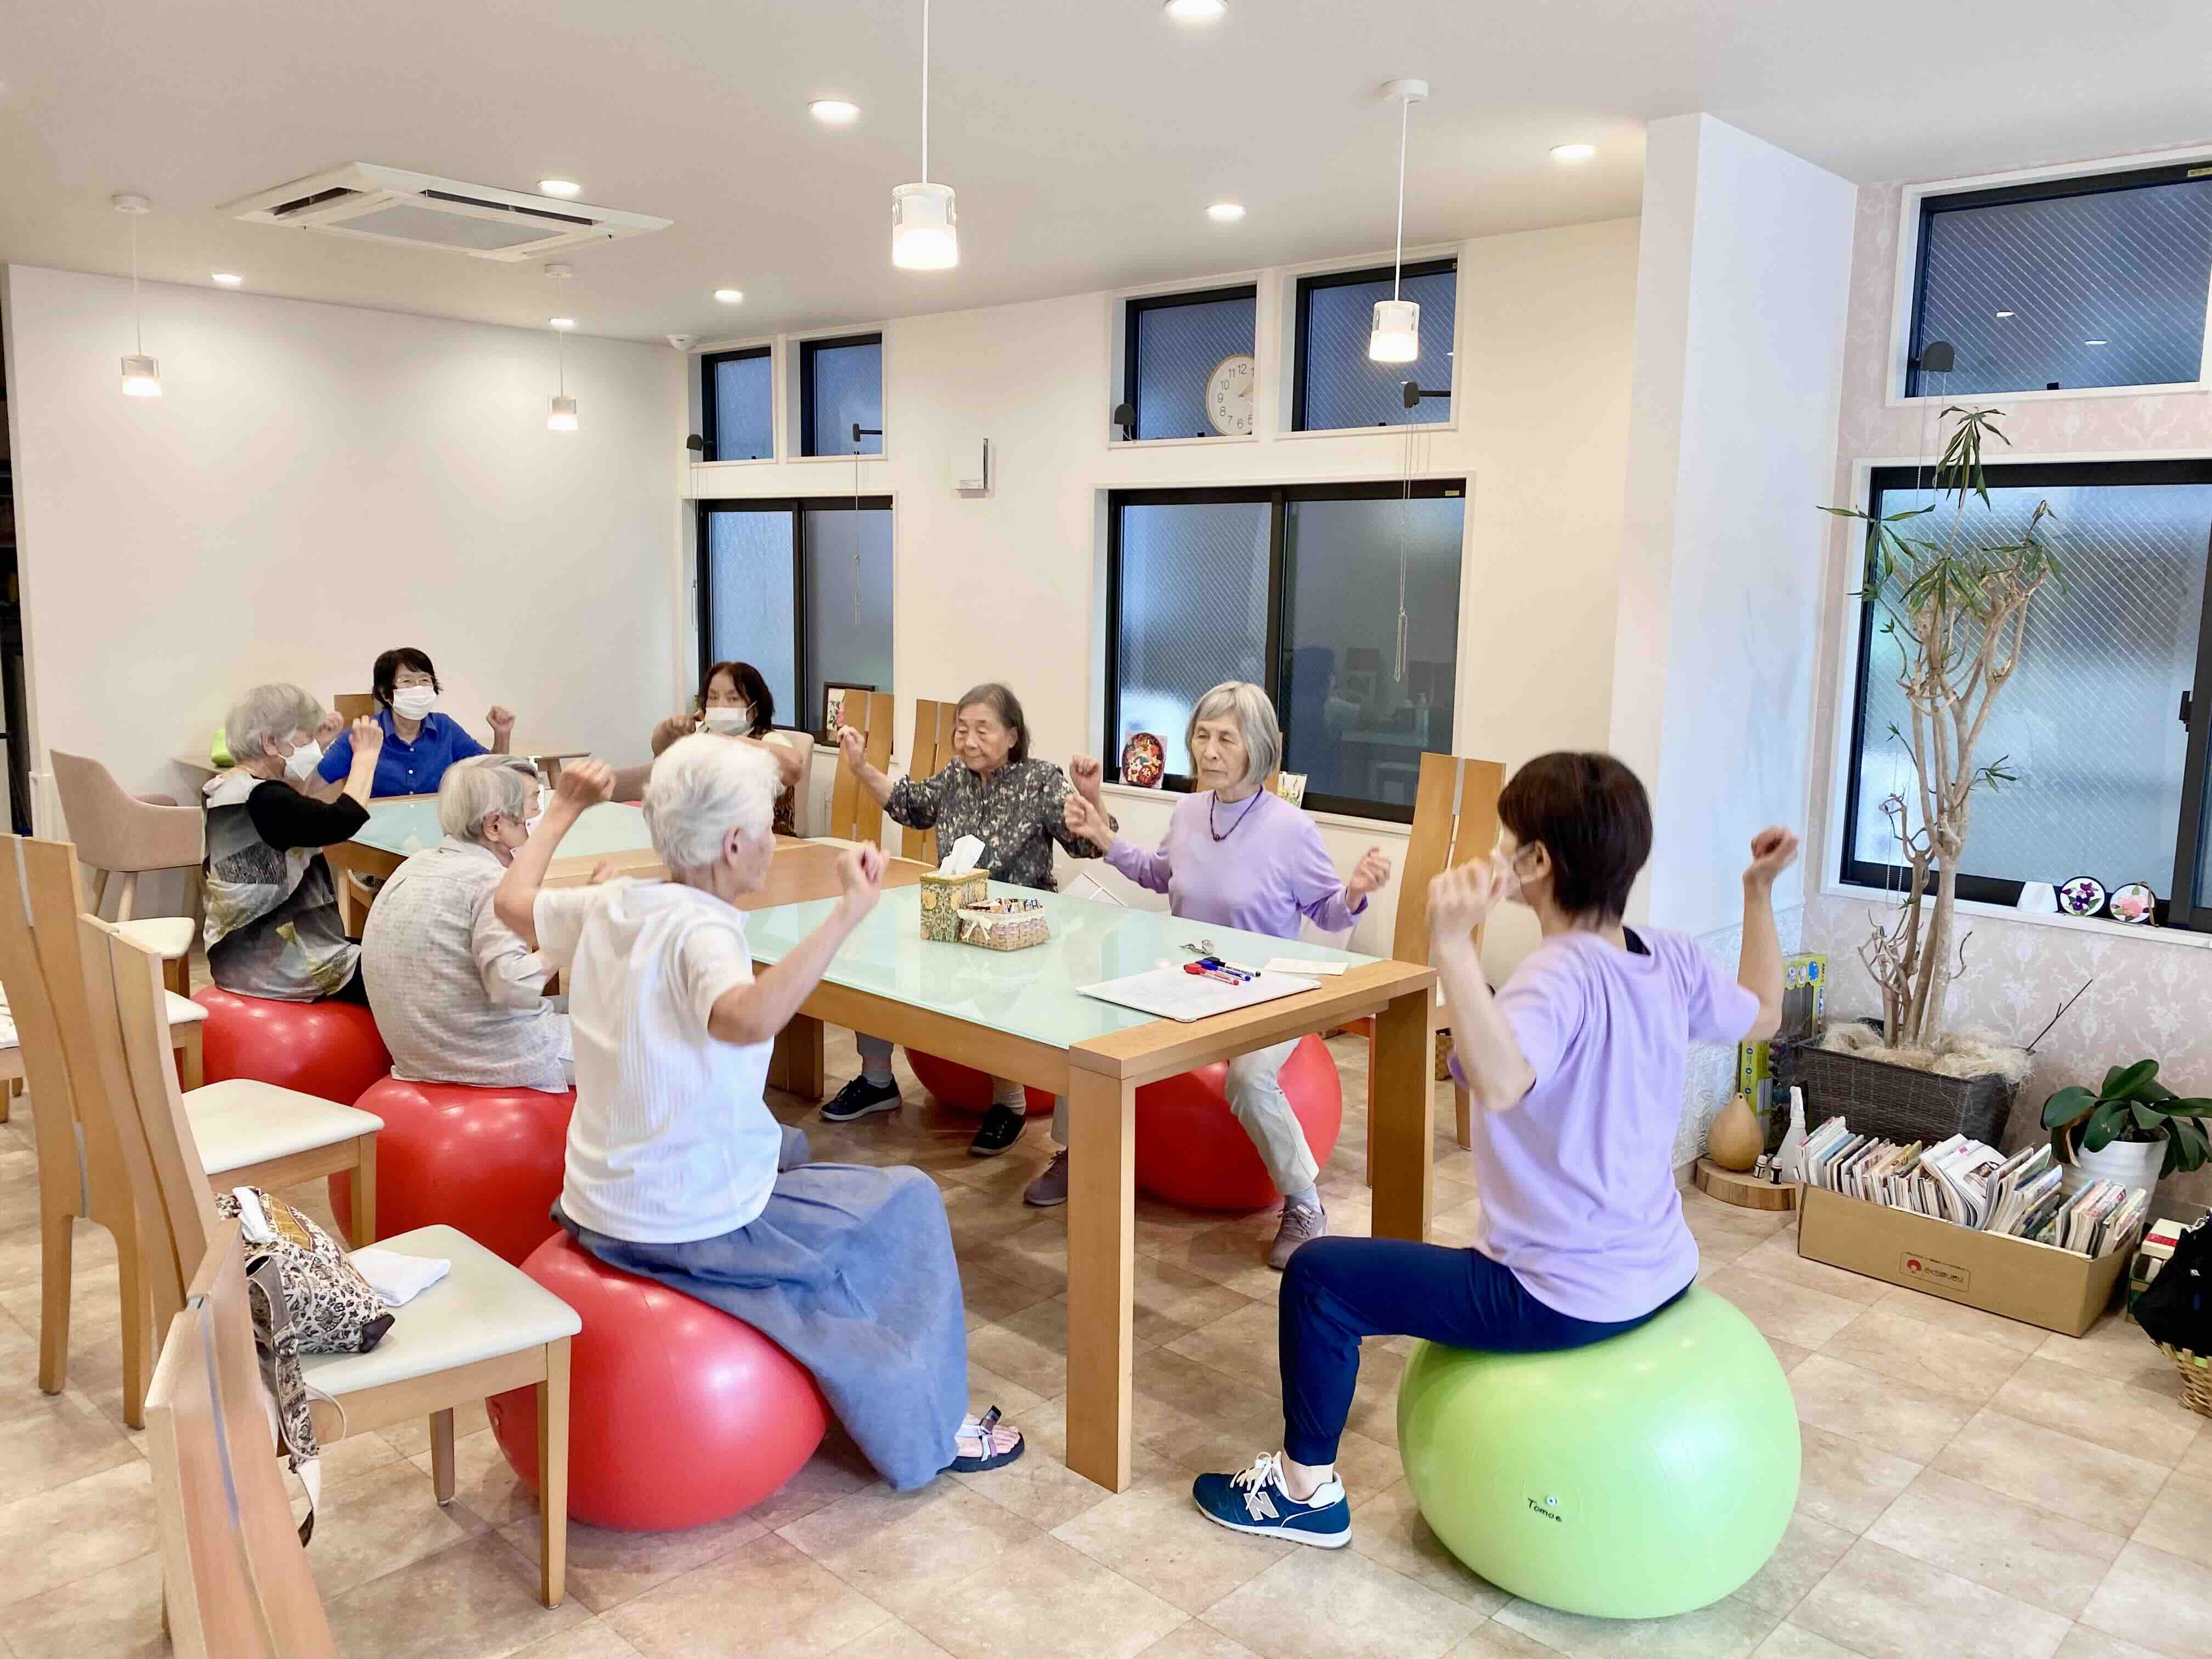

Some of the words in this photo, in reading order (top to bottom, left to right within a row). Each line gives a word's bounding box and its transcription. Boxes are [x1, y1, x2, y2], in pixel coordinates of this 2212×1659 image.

[1228, 368, 1235, 377] 11
[1238, 364, 1247, 374] 12
[1220, 379, 1229, 391] 10
[1217, 393, 1223, 403] 9
[1220, 407, 1226, 416] 8
[1228, 416, 1233, 426] 7
[1237, 419, 1243, 429] 6
[1243, 1491, 1279, 1521] N
[1527, 1497, 1562, 1523] Tomoe
